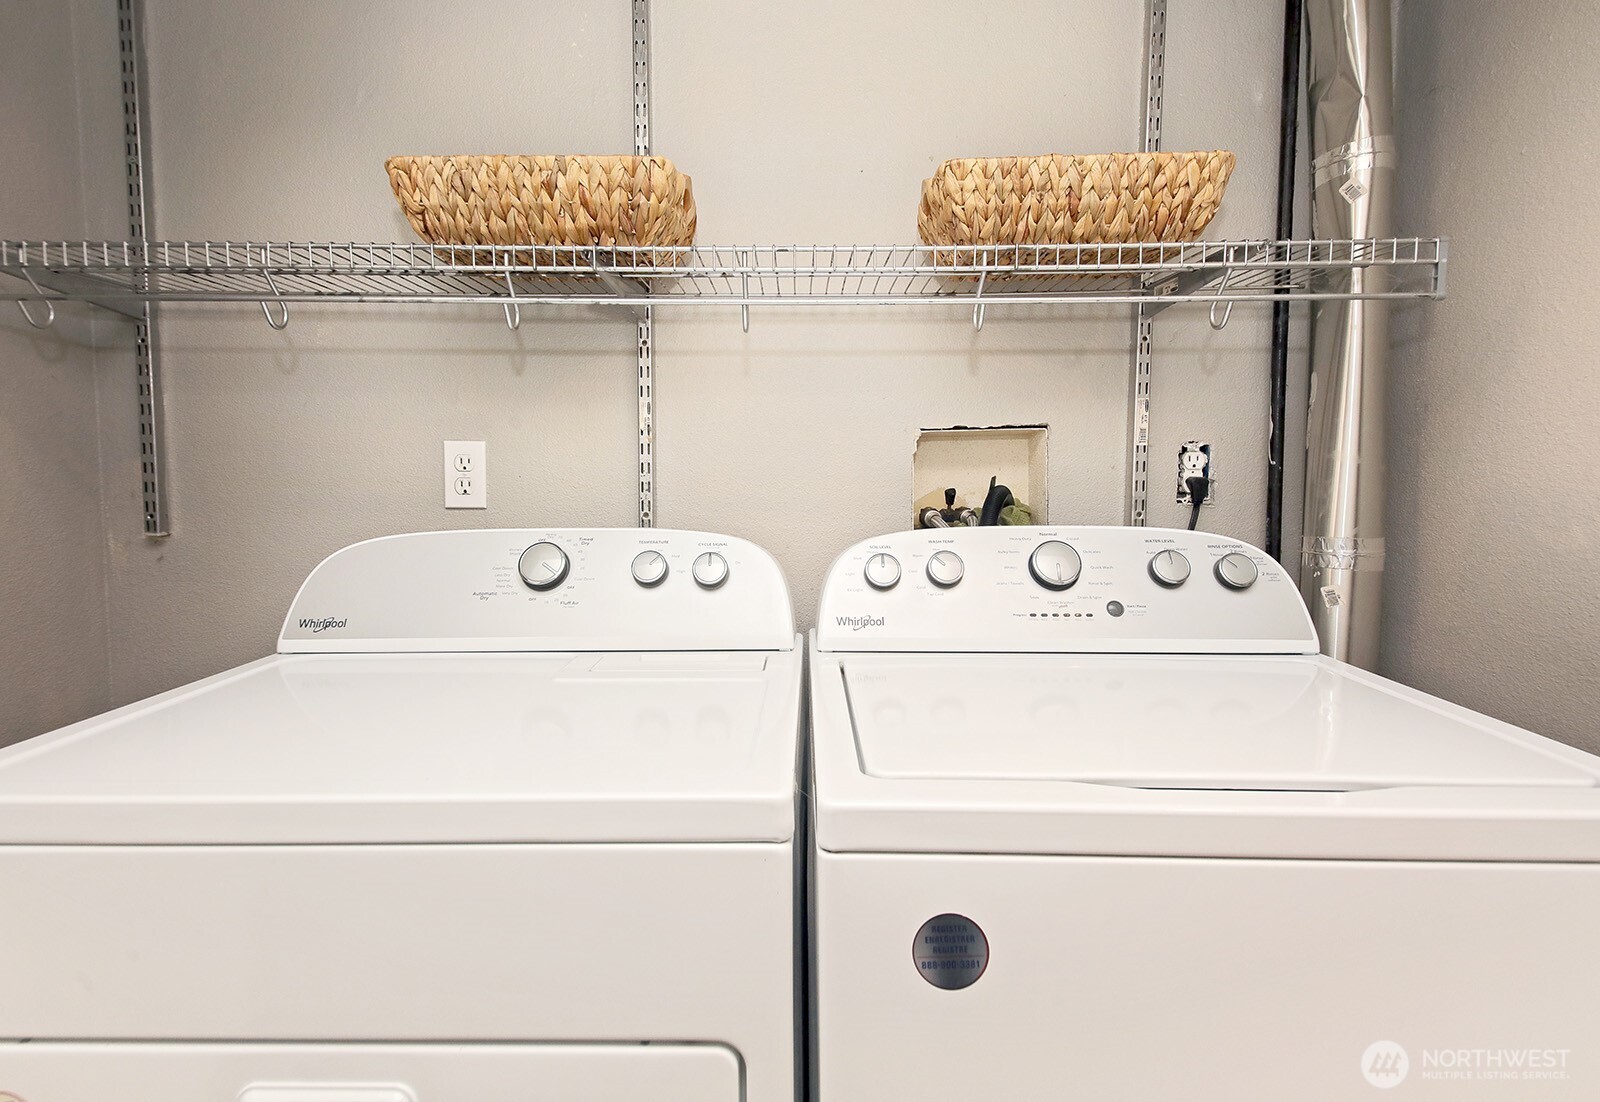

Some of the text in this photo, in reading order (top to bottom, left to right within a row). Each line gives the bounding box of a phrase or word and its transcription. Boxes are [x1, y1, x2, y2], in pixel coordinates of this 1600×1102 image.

[299, 617, 348, 632] Whirlpool
[836, 615, 885, 631] Whirlpool
[931, 925, 968, 933] REGISTER
